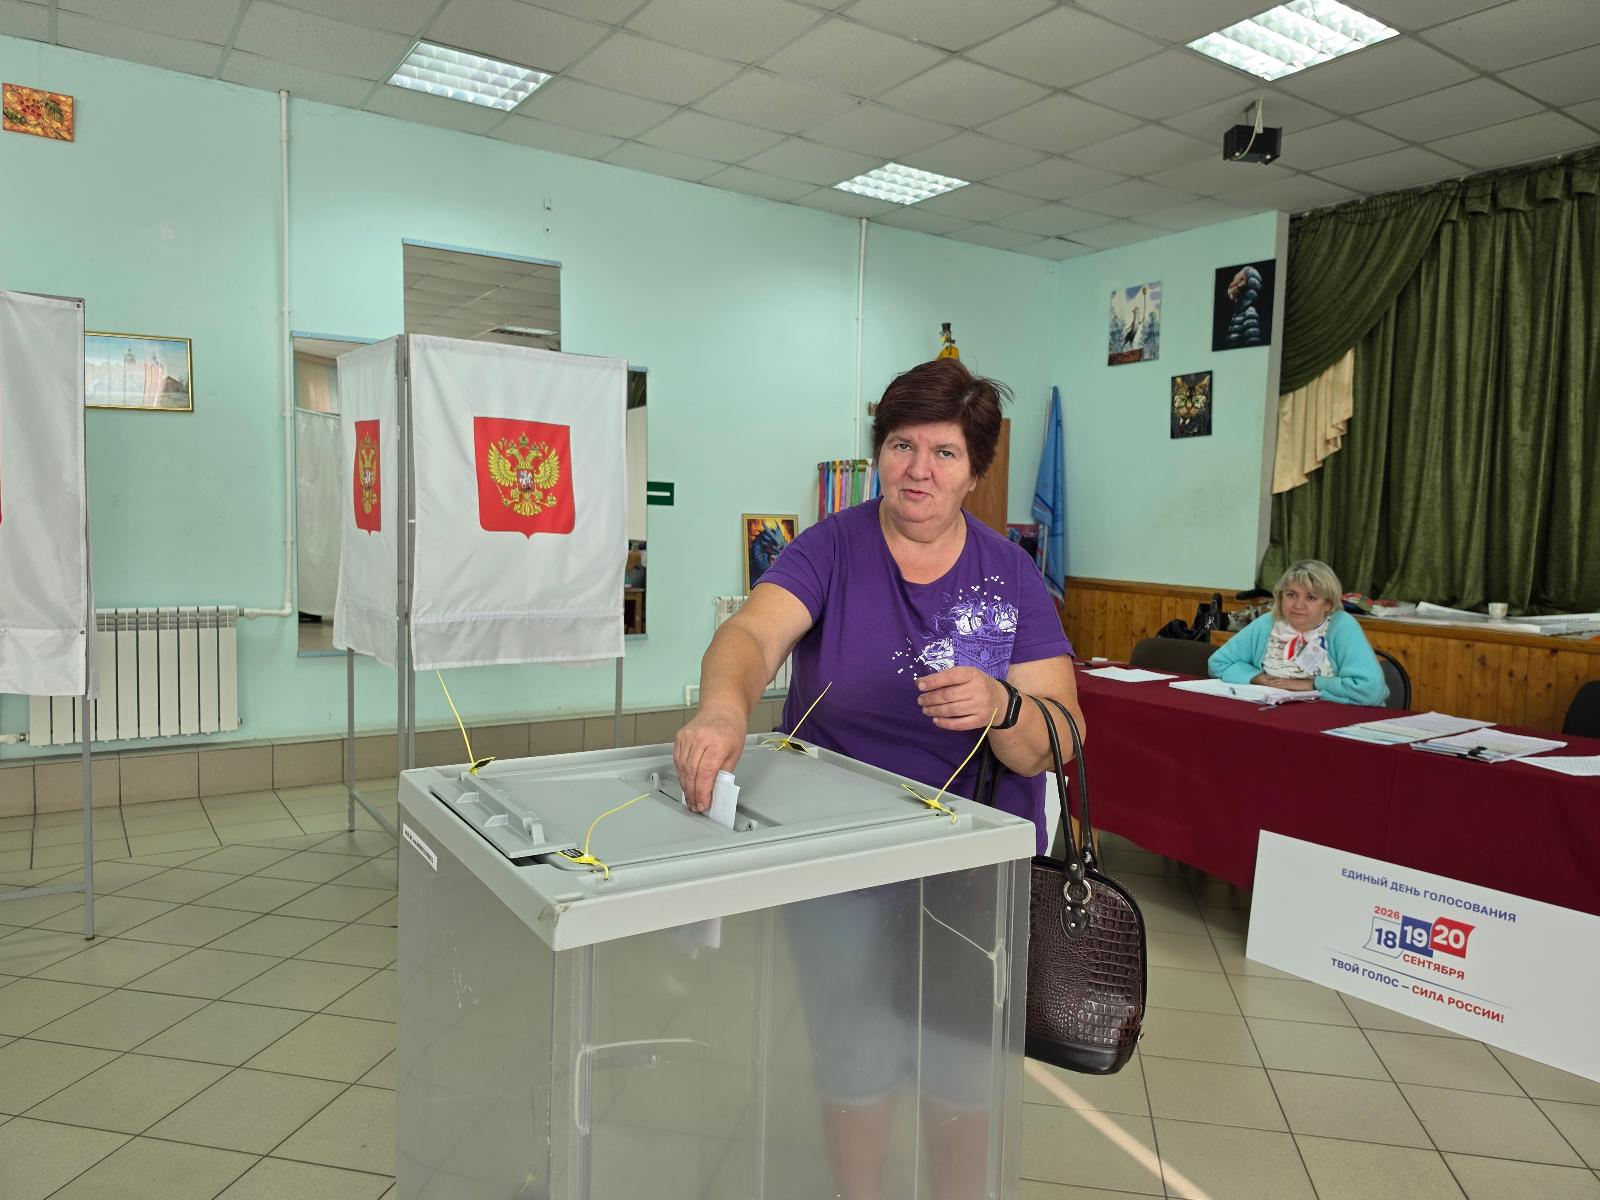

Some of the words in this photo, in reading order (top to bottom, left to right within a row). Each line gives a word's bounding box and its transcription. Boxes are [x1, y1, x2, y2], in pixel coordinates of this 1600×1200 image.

[1341, 868, 1388, 888] ЕДИНЫЙ
[1390, 880, 1420, 896] ДЕНЬ
[1423, 889, 1516, 922] ГОЛОСОВАНИЯ
[1374, 906, 1400, 920] 2026
[1375, 928, 1397, 949] 18
[1404, 925, 1427, 947] 19
[1434, 924, 1466, 949] 20
[1403, 953, 1465, 980] СЕНТЯБРЯ
[1331, 958, 1360, 974] ТВОЙ
[1362, 969, 1399, 987] ГОЛОС
[1412, 985, 1444, 1003] СИЛА
[1448, 997, 1504, 1023] РОССИИ!
